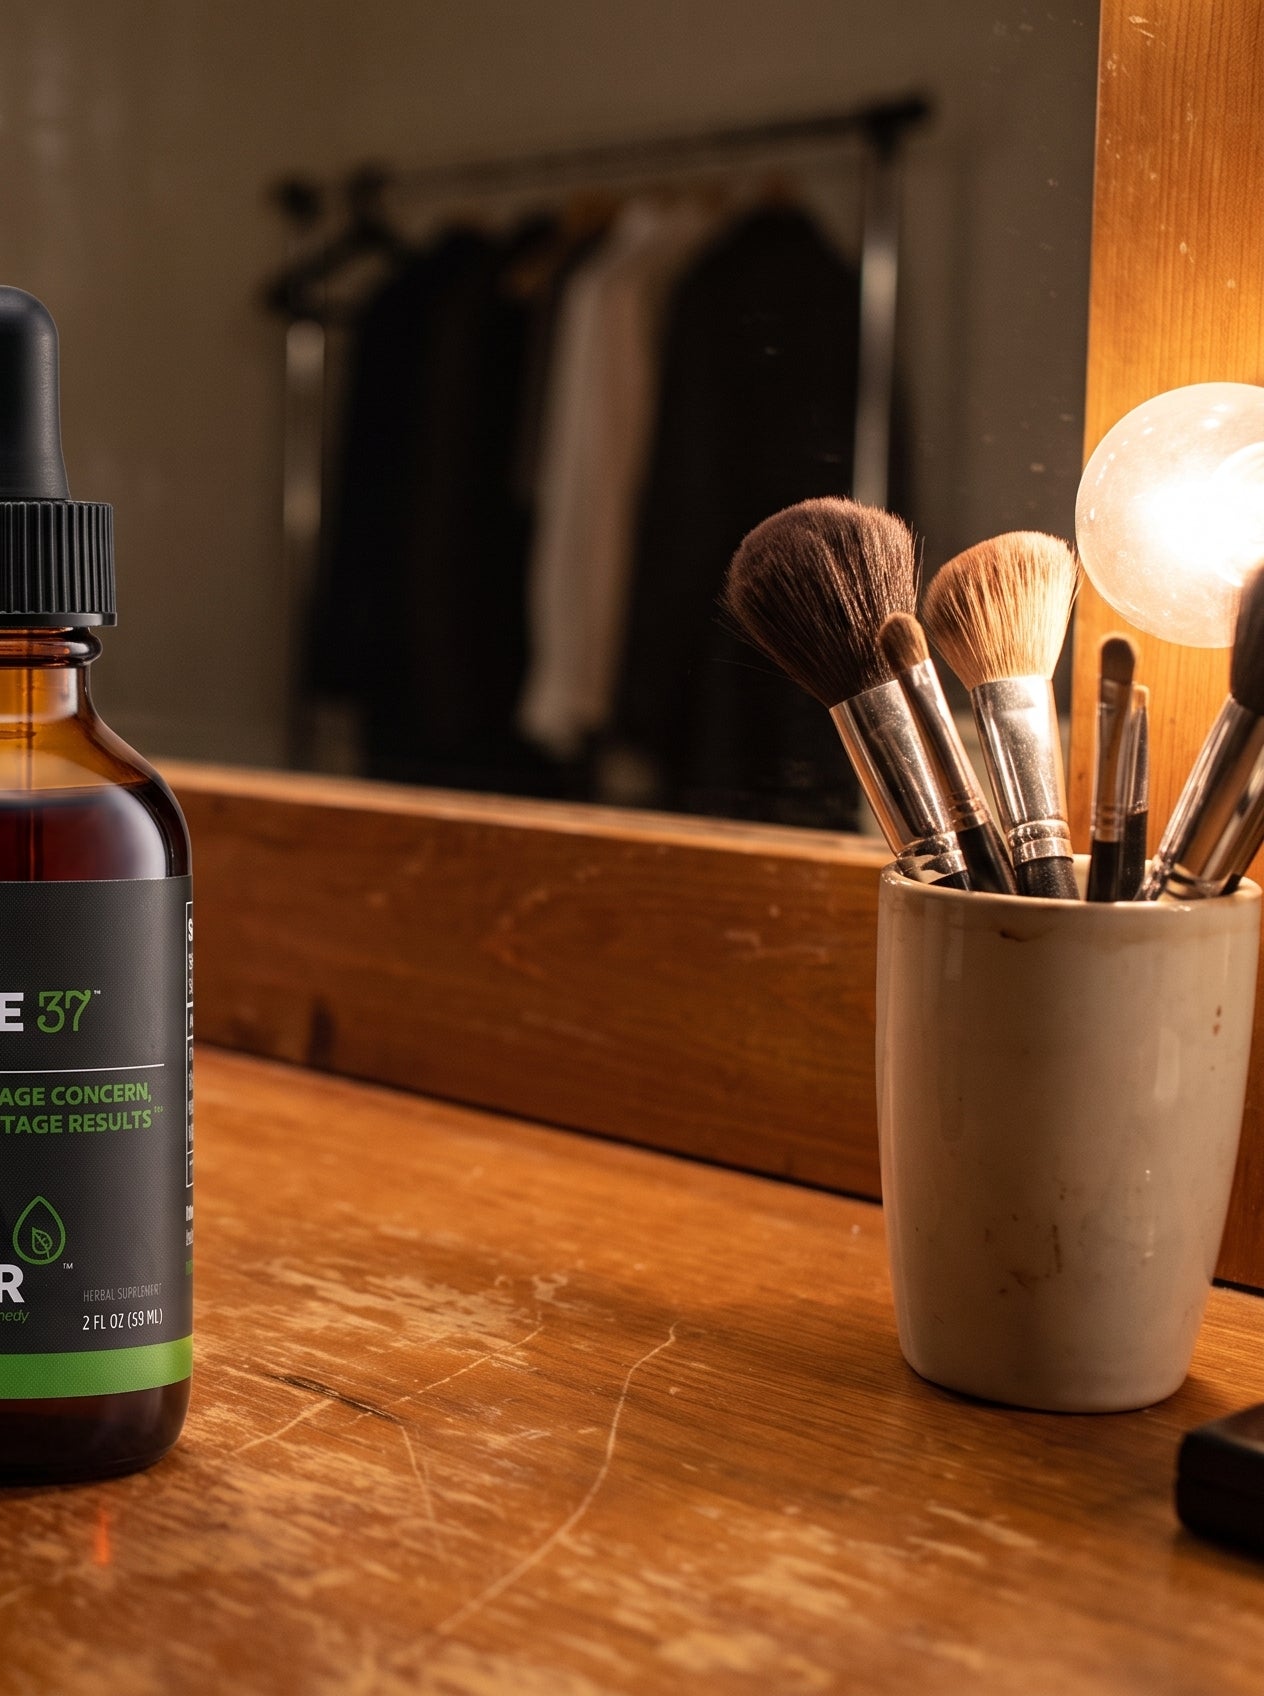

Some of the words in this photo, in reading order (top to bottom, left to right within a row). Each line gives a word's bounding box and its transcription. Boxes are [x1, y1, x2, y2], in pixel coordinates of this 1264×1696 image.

[37, 989, 91, 1033] 37
[51, 1082, 152, 1105] CONCERN,
[68, 1109, 152, 1132] RESULTS
[83, 1289, 115, 1302] HERBAL
[82, 1315, 90, 1331] 2
[94, 1314, 106, 1330] FL
[109, 1313, 124, 1329] OZ
[147, 1308, 163, 1325] ML)
